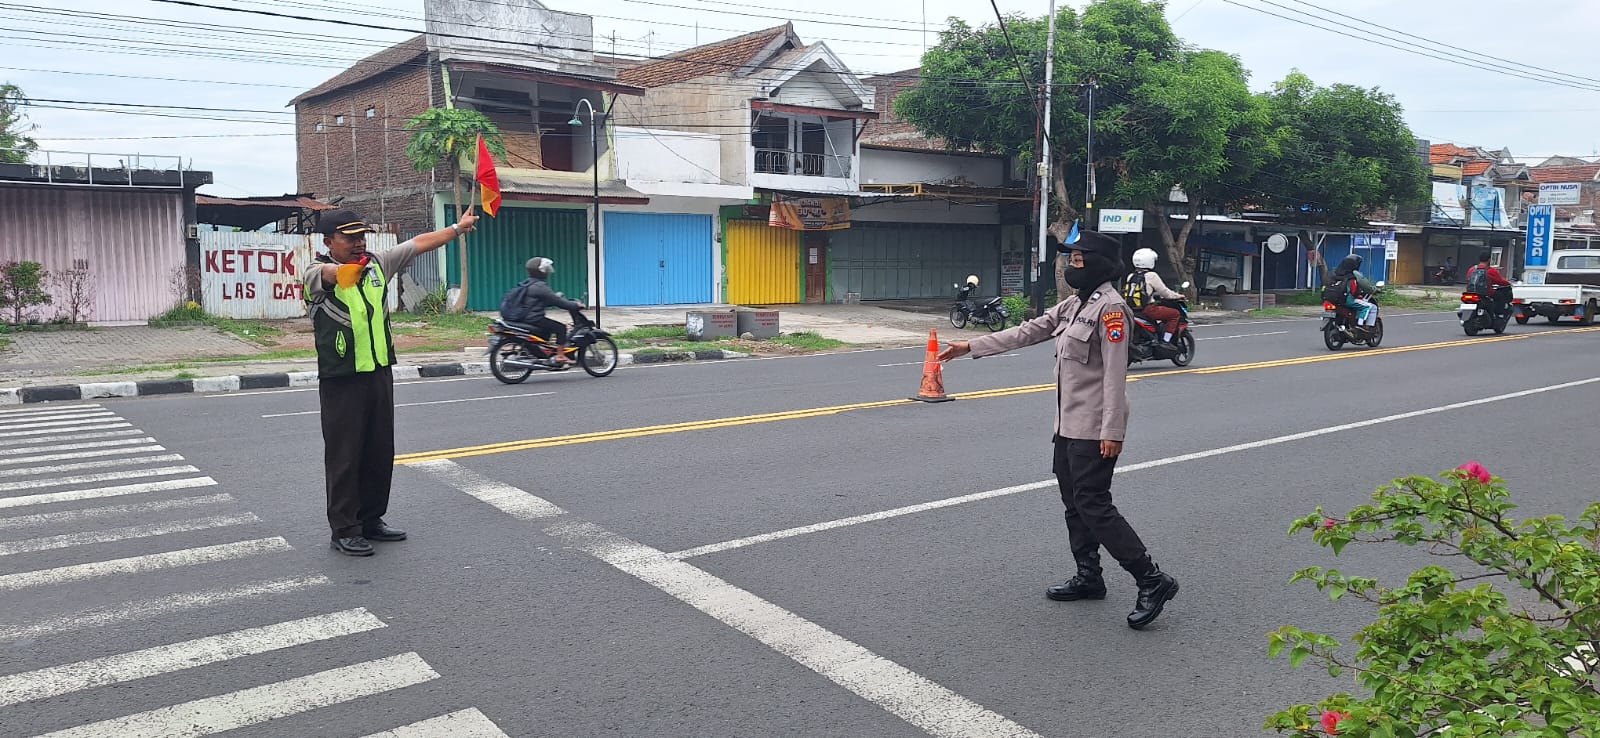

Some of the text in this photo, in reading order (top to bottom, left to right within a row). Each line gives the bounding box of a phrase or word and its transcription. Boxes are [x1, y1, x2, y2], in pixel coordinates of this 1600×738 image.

[1529, 205, 1551, 216] OPTIK
[1532, 218, 1544, 256] NUSA
[205, 250, 295, 276] KETOK
[223, 282, 305, 301] LAS CAT
[1076, 316, 1096, 328] POLRI
